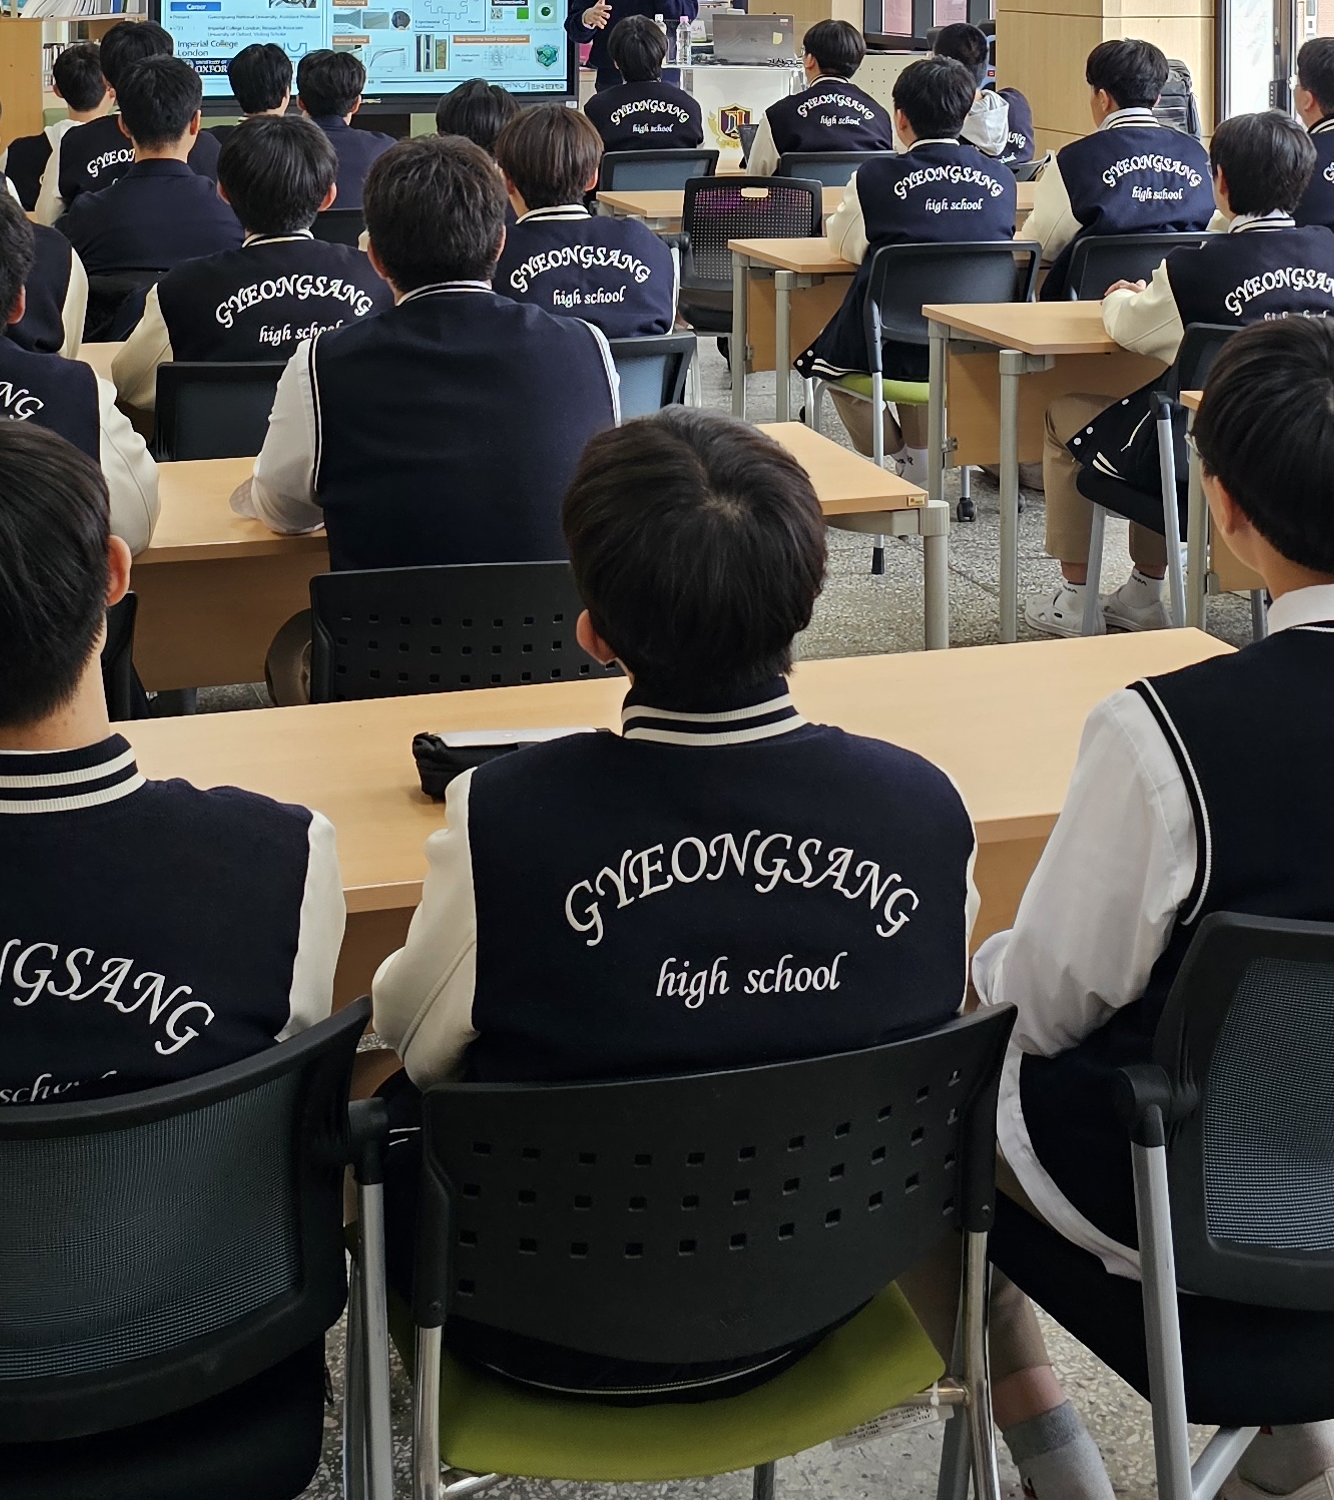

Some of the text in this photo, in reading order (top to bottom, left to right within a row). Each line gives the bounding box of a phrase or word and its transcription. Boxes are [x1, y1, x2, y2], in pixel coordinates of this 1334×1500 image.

[177, 40, 238, 49] Imperial College
[177, 49, 208, 57] London
[195, 65, 228, 73] OXFOR
[767, 57, 803, 68] 경상고등
[610, 98, 690, 126] GYEONGSANG
[797, 93, 875, 121] GYEONGSANG
[632, 122, 673, 134] high school
[820, 115, 861, 127] high school
[1102, 153, 1203, 188] GYEONGSANG
[893, 164, 1004, 200] GYEONGSANG
[1132, 185, 1183, 202] high school
[924, 197, 983, 214] high school
[510, 244, 652, 294] GYEONGSANG
[215, 274, 373, 329] GYEONGSANG
[553, 286, 626, 308] high school
[259, 323, 291, 346] high
[565, 830, 919, 946] GYEONGSANG
[656, 952, 848, 1009] high school
